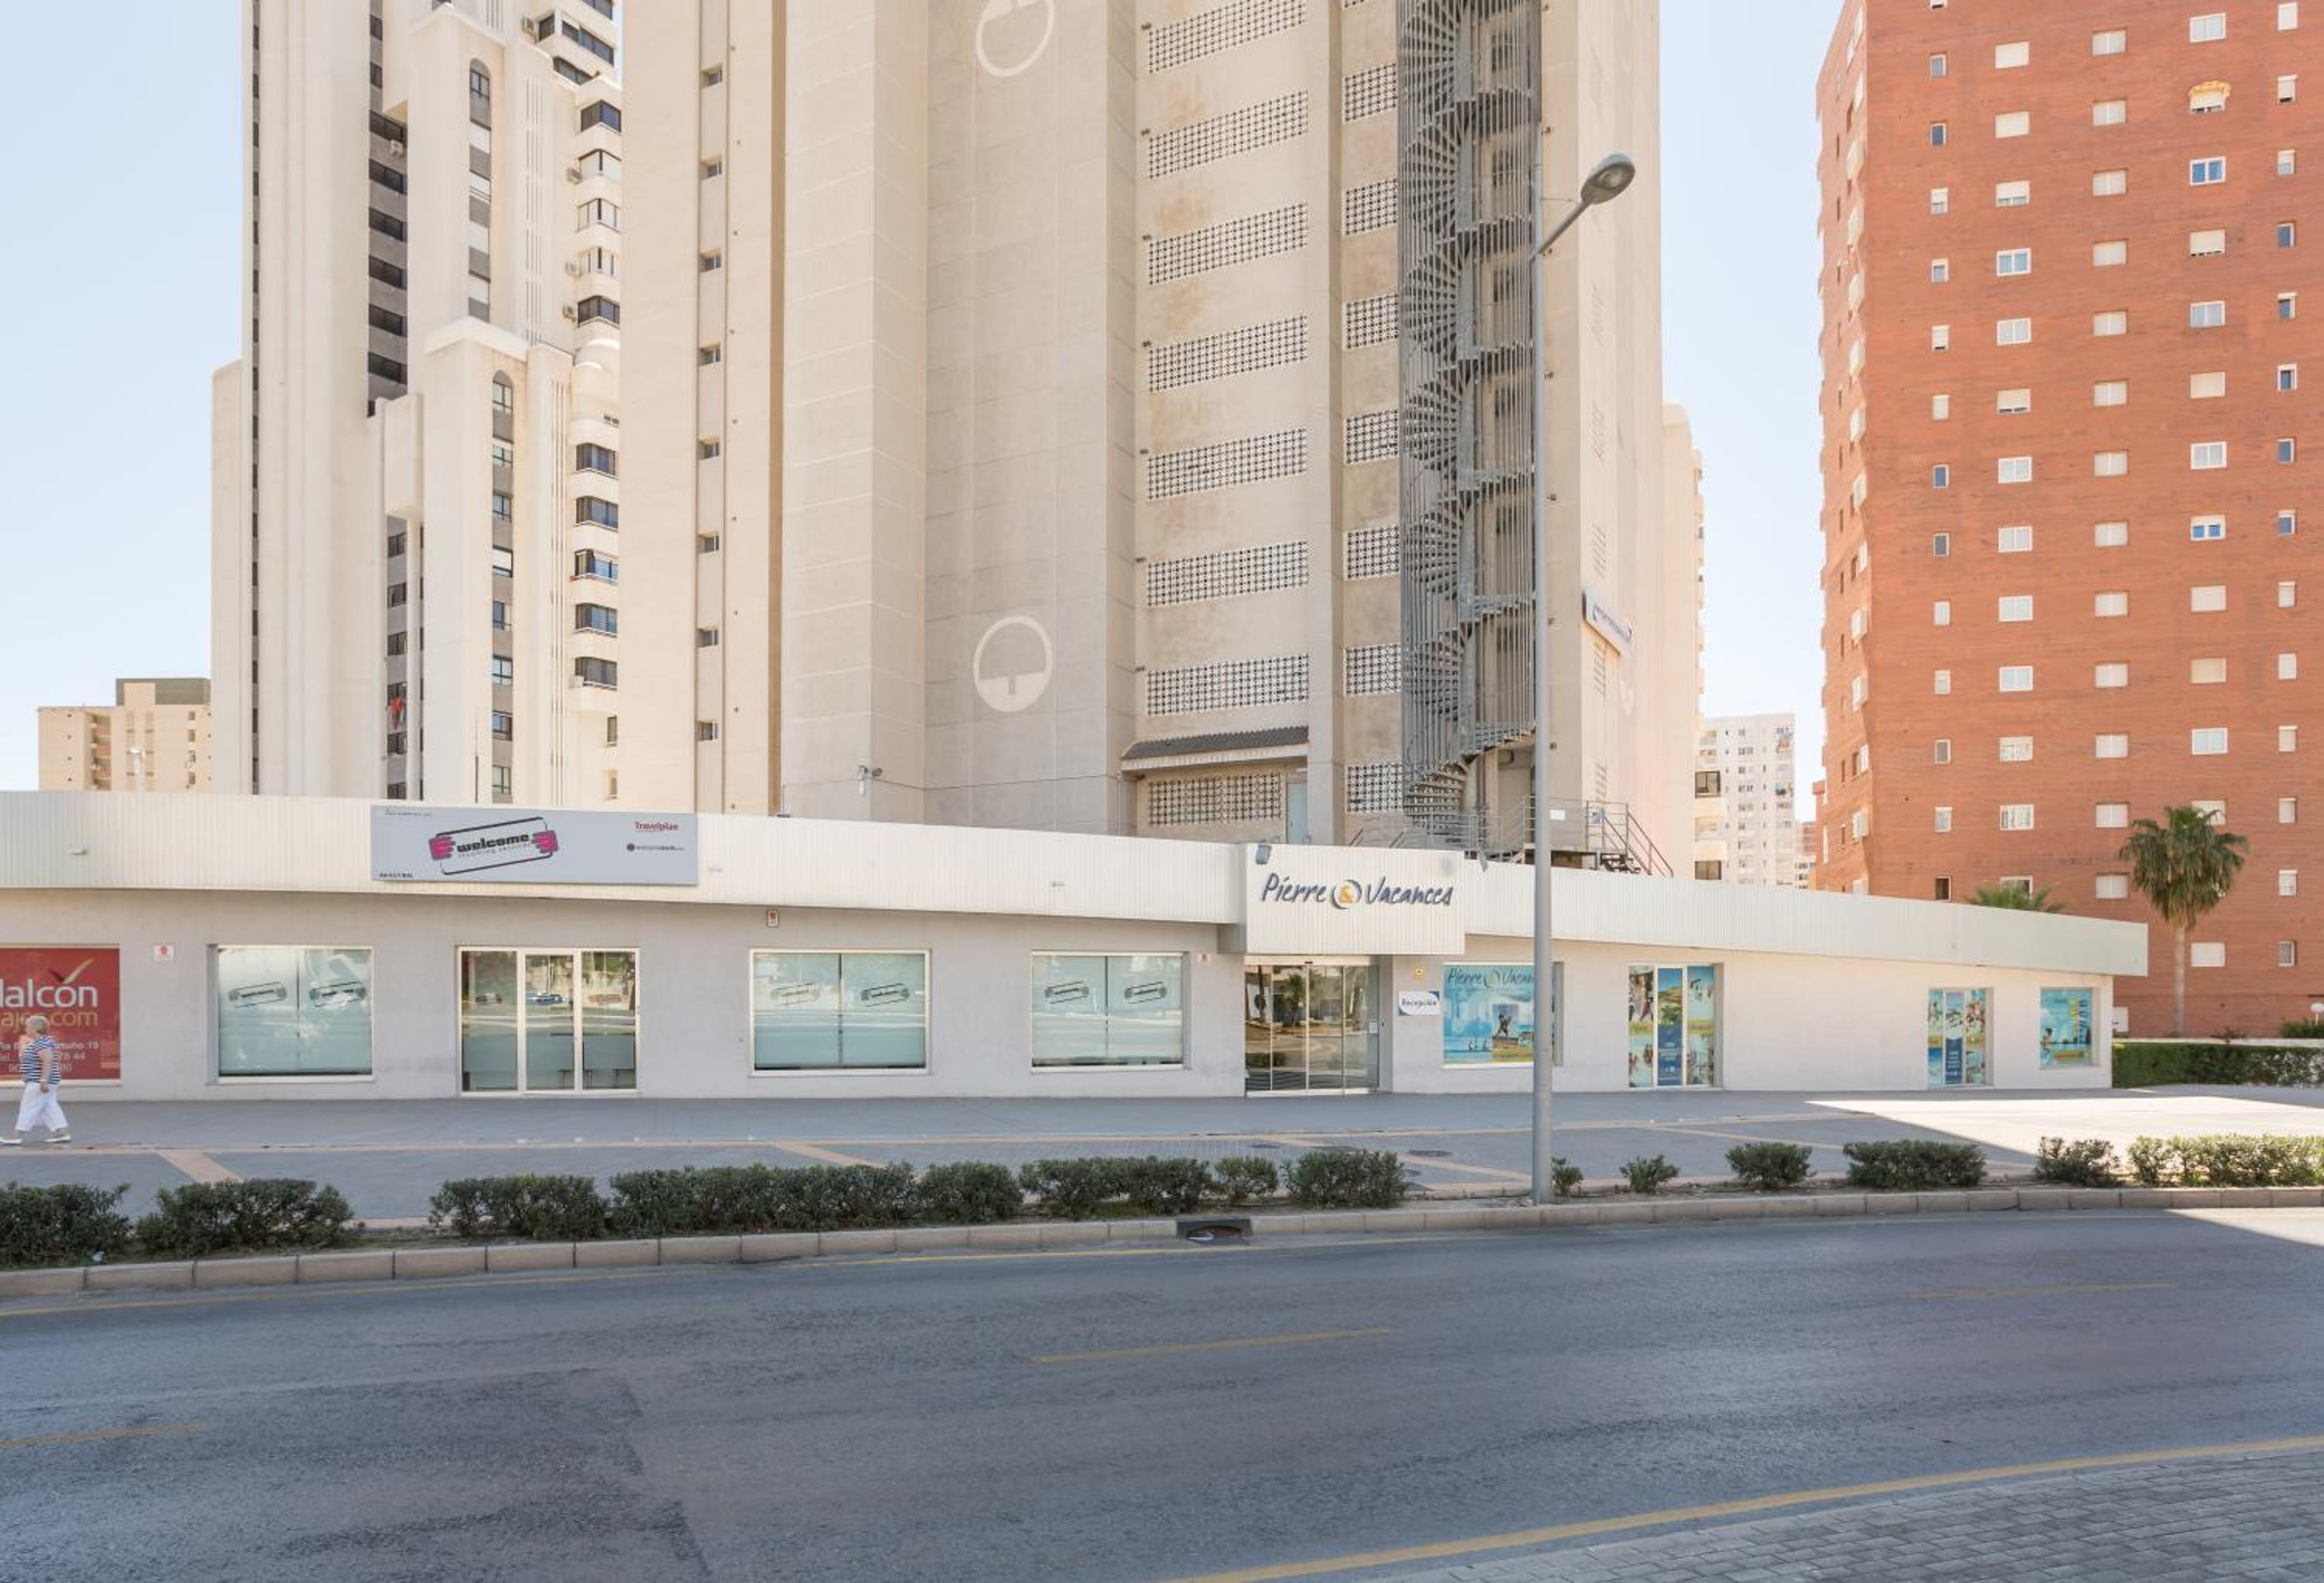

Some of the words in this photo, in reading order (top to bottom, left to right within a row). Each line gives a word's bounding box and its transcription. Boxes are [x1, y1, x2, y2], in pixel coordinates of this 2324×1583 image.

[456, 834, 529, 852] welcome
[1261, 872, 1326, 902] Pierre
[1366, 876, 1453, 905] Vacances
[1448, 967, 1481, 985] Pierre
[1502, 967, 1536, 984] Vacan
